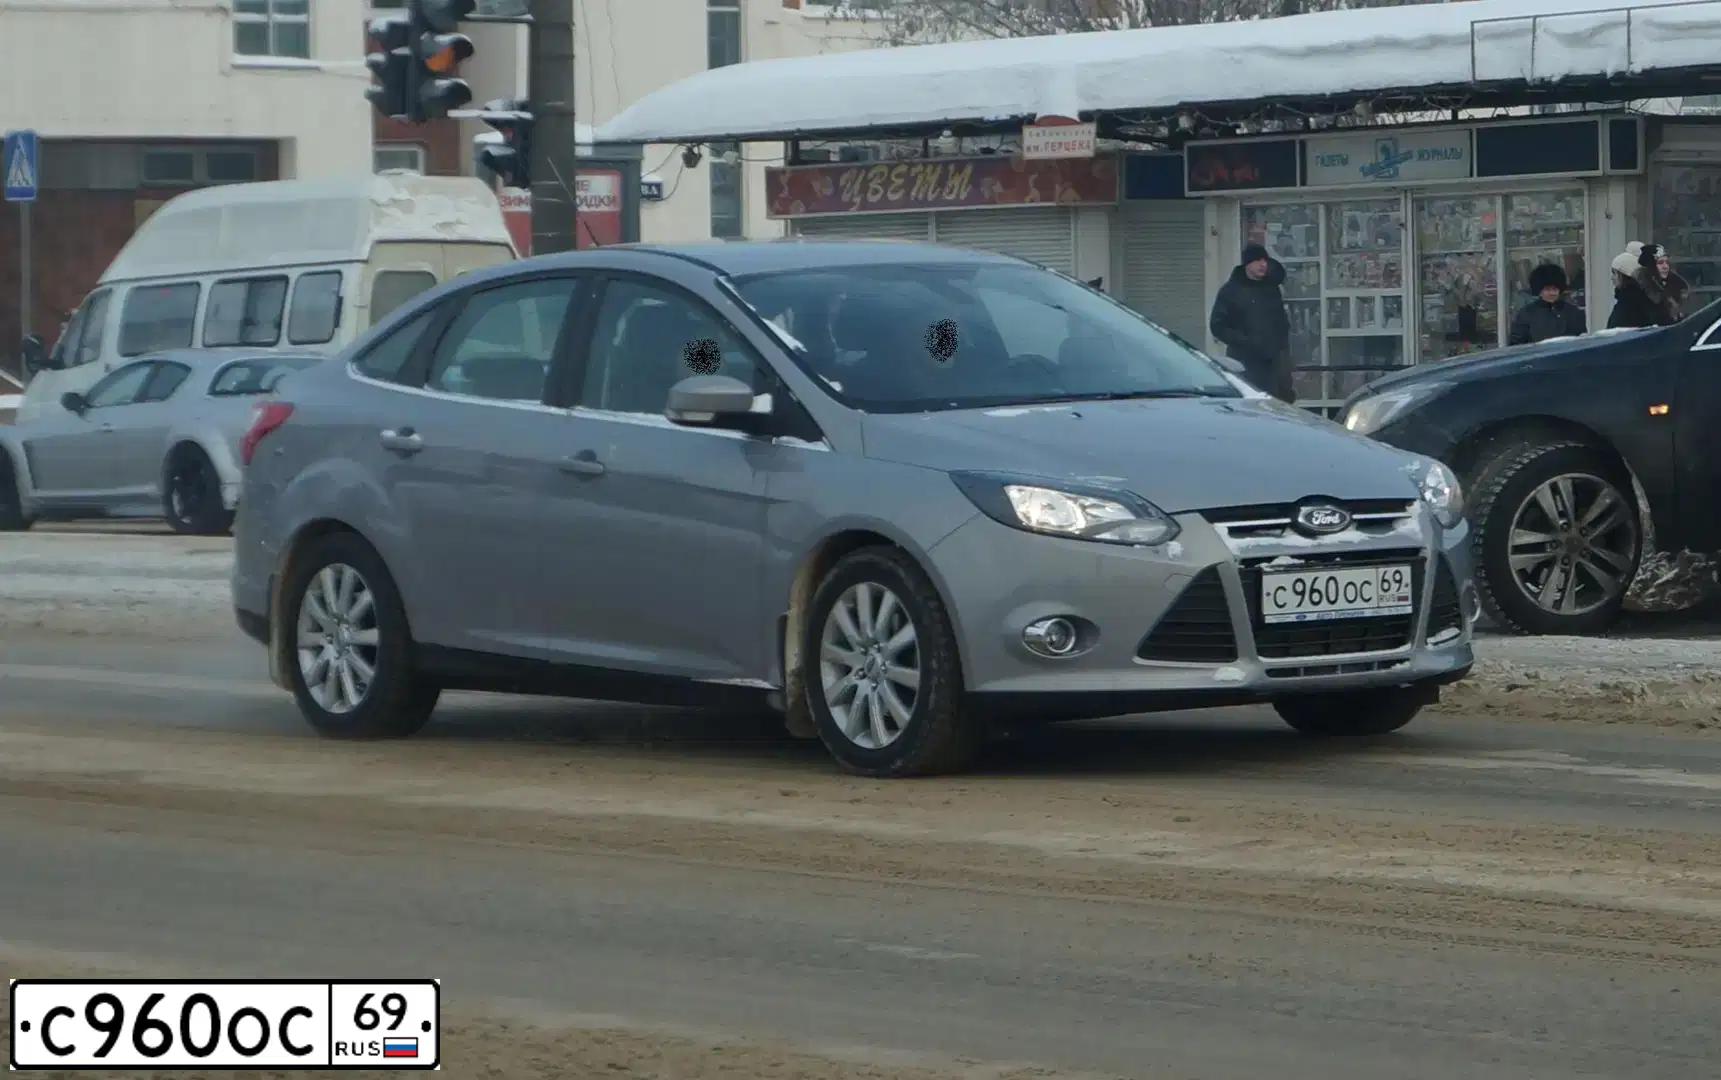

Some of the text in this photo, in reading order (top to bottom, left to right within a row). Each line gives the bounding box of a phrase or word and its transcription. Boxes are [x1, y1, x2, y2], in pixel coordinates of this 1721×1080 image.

[839, 163, 974, 212] ЦВЕТЫ
[1311, 510, 1341, 525] Ford
[1380, 569, 1403, 593] 69
